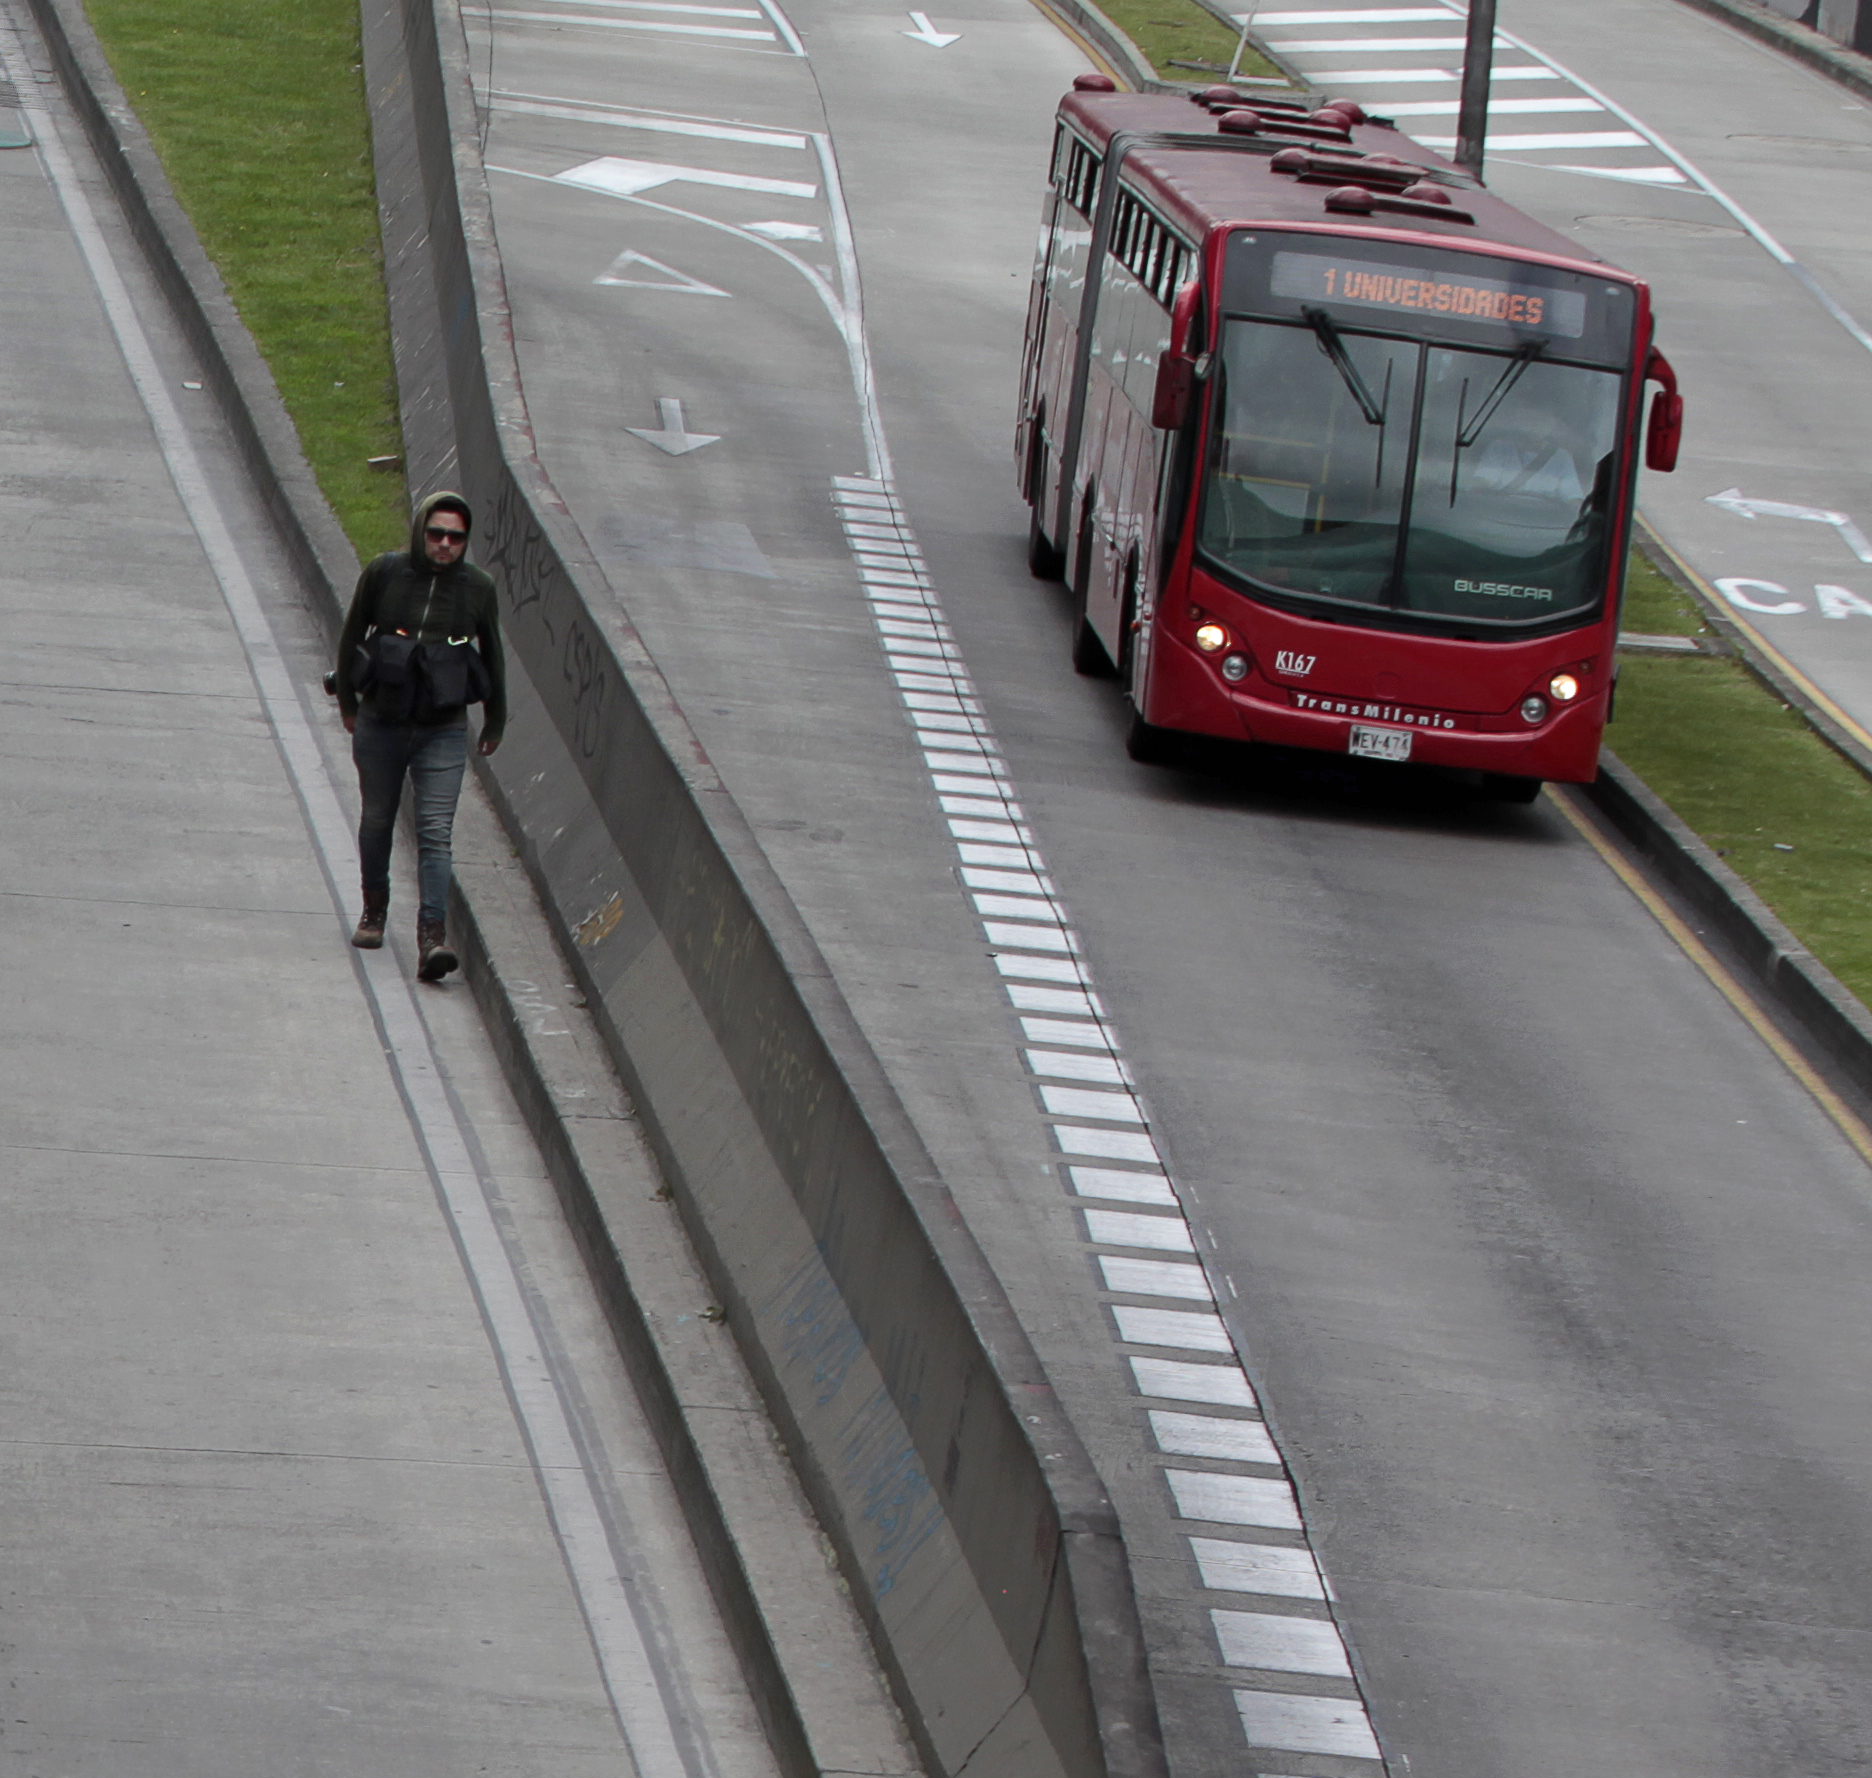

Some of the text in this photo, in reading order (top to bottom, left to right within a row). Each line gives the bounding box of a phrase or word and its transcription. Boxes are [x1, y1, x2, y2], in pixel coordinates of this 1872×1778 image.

[1324, 268, 1544, 324] 1 UNIVERSIDADES
[1455, 580, 1552, 600] BUSSCAR
[1275, 651, 1316, 674] K167
[1297, 694, 1455, 729] TransMilenio
